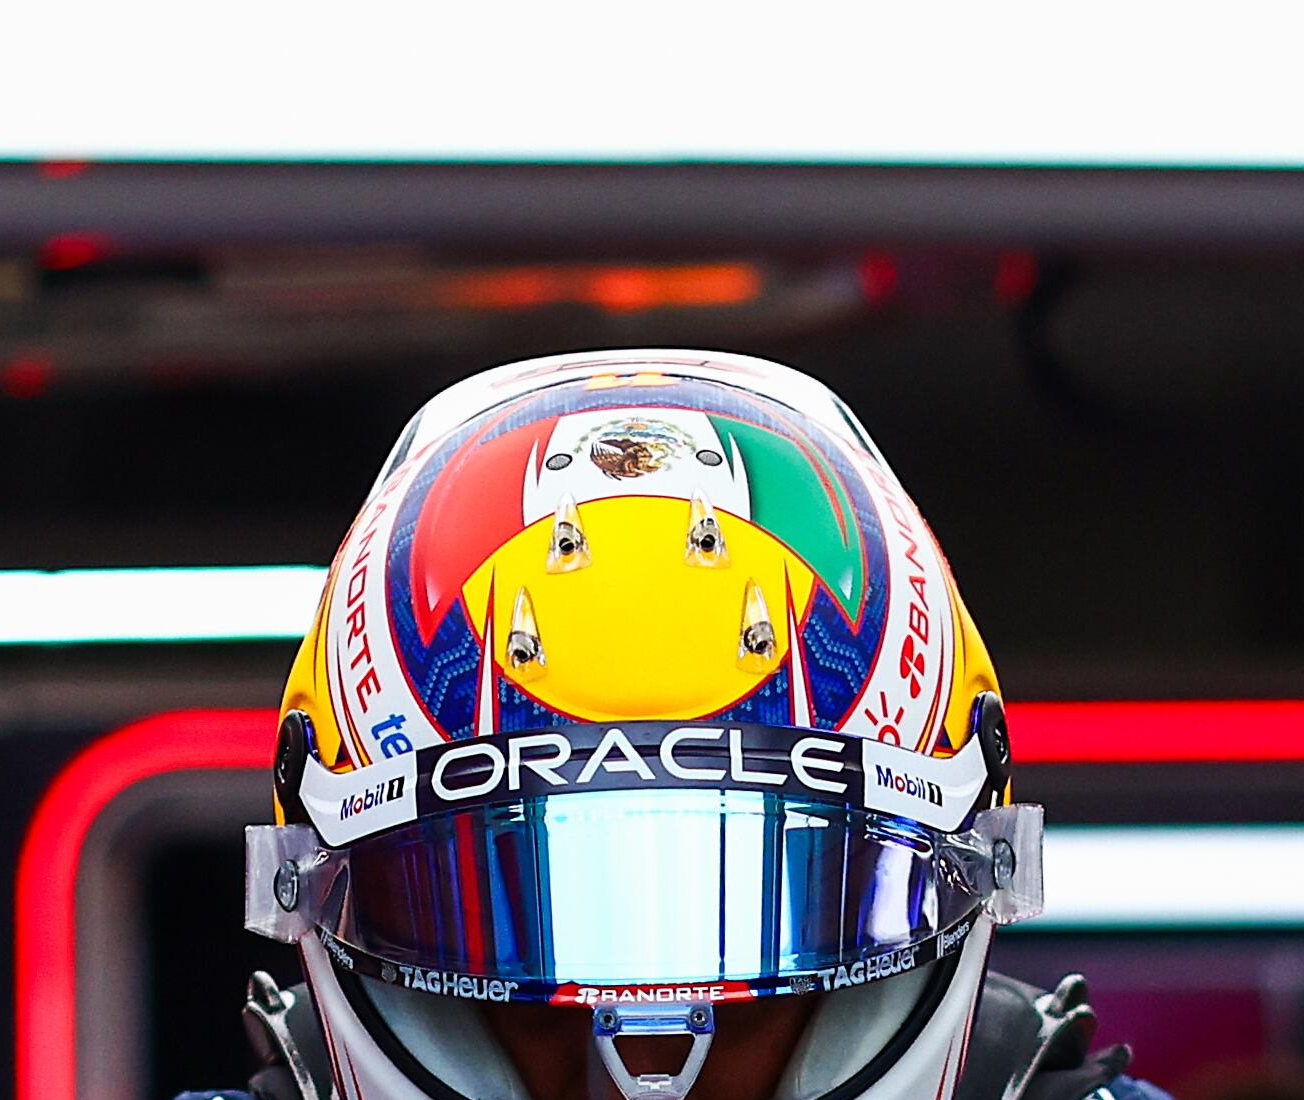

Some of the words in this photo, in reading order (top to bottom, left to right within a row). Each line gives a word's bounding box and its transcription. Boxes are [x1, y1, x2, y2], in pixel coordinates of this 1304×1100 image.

[431, 727, 848, 801] ORACLE
[876, 764, 926, 800] Mobil
[340, 783, 385, 821] Mobil
[601, 986, 725, 1003] BANORTE
